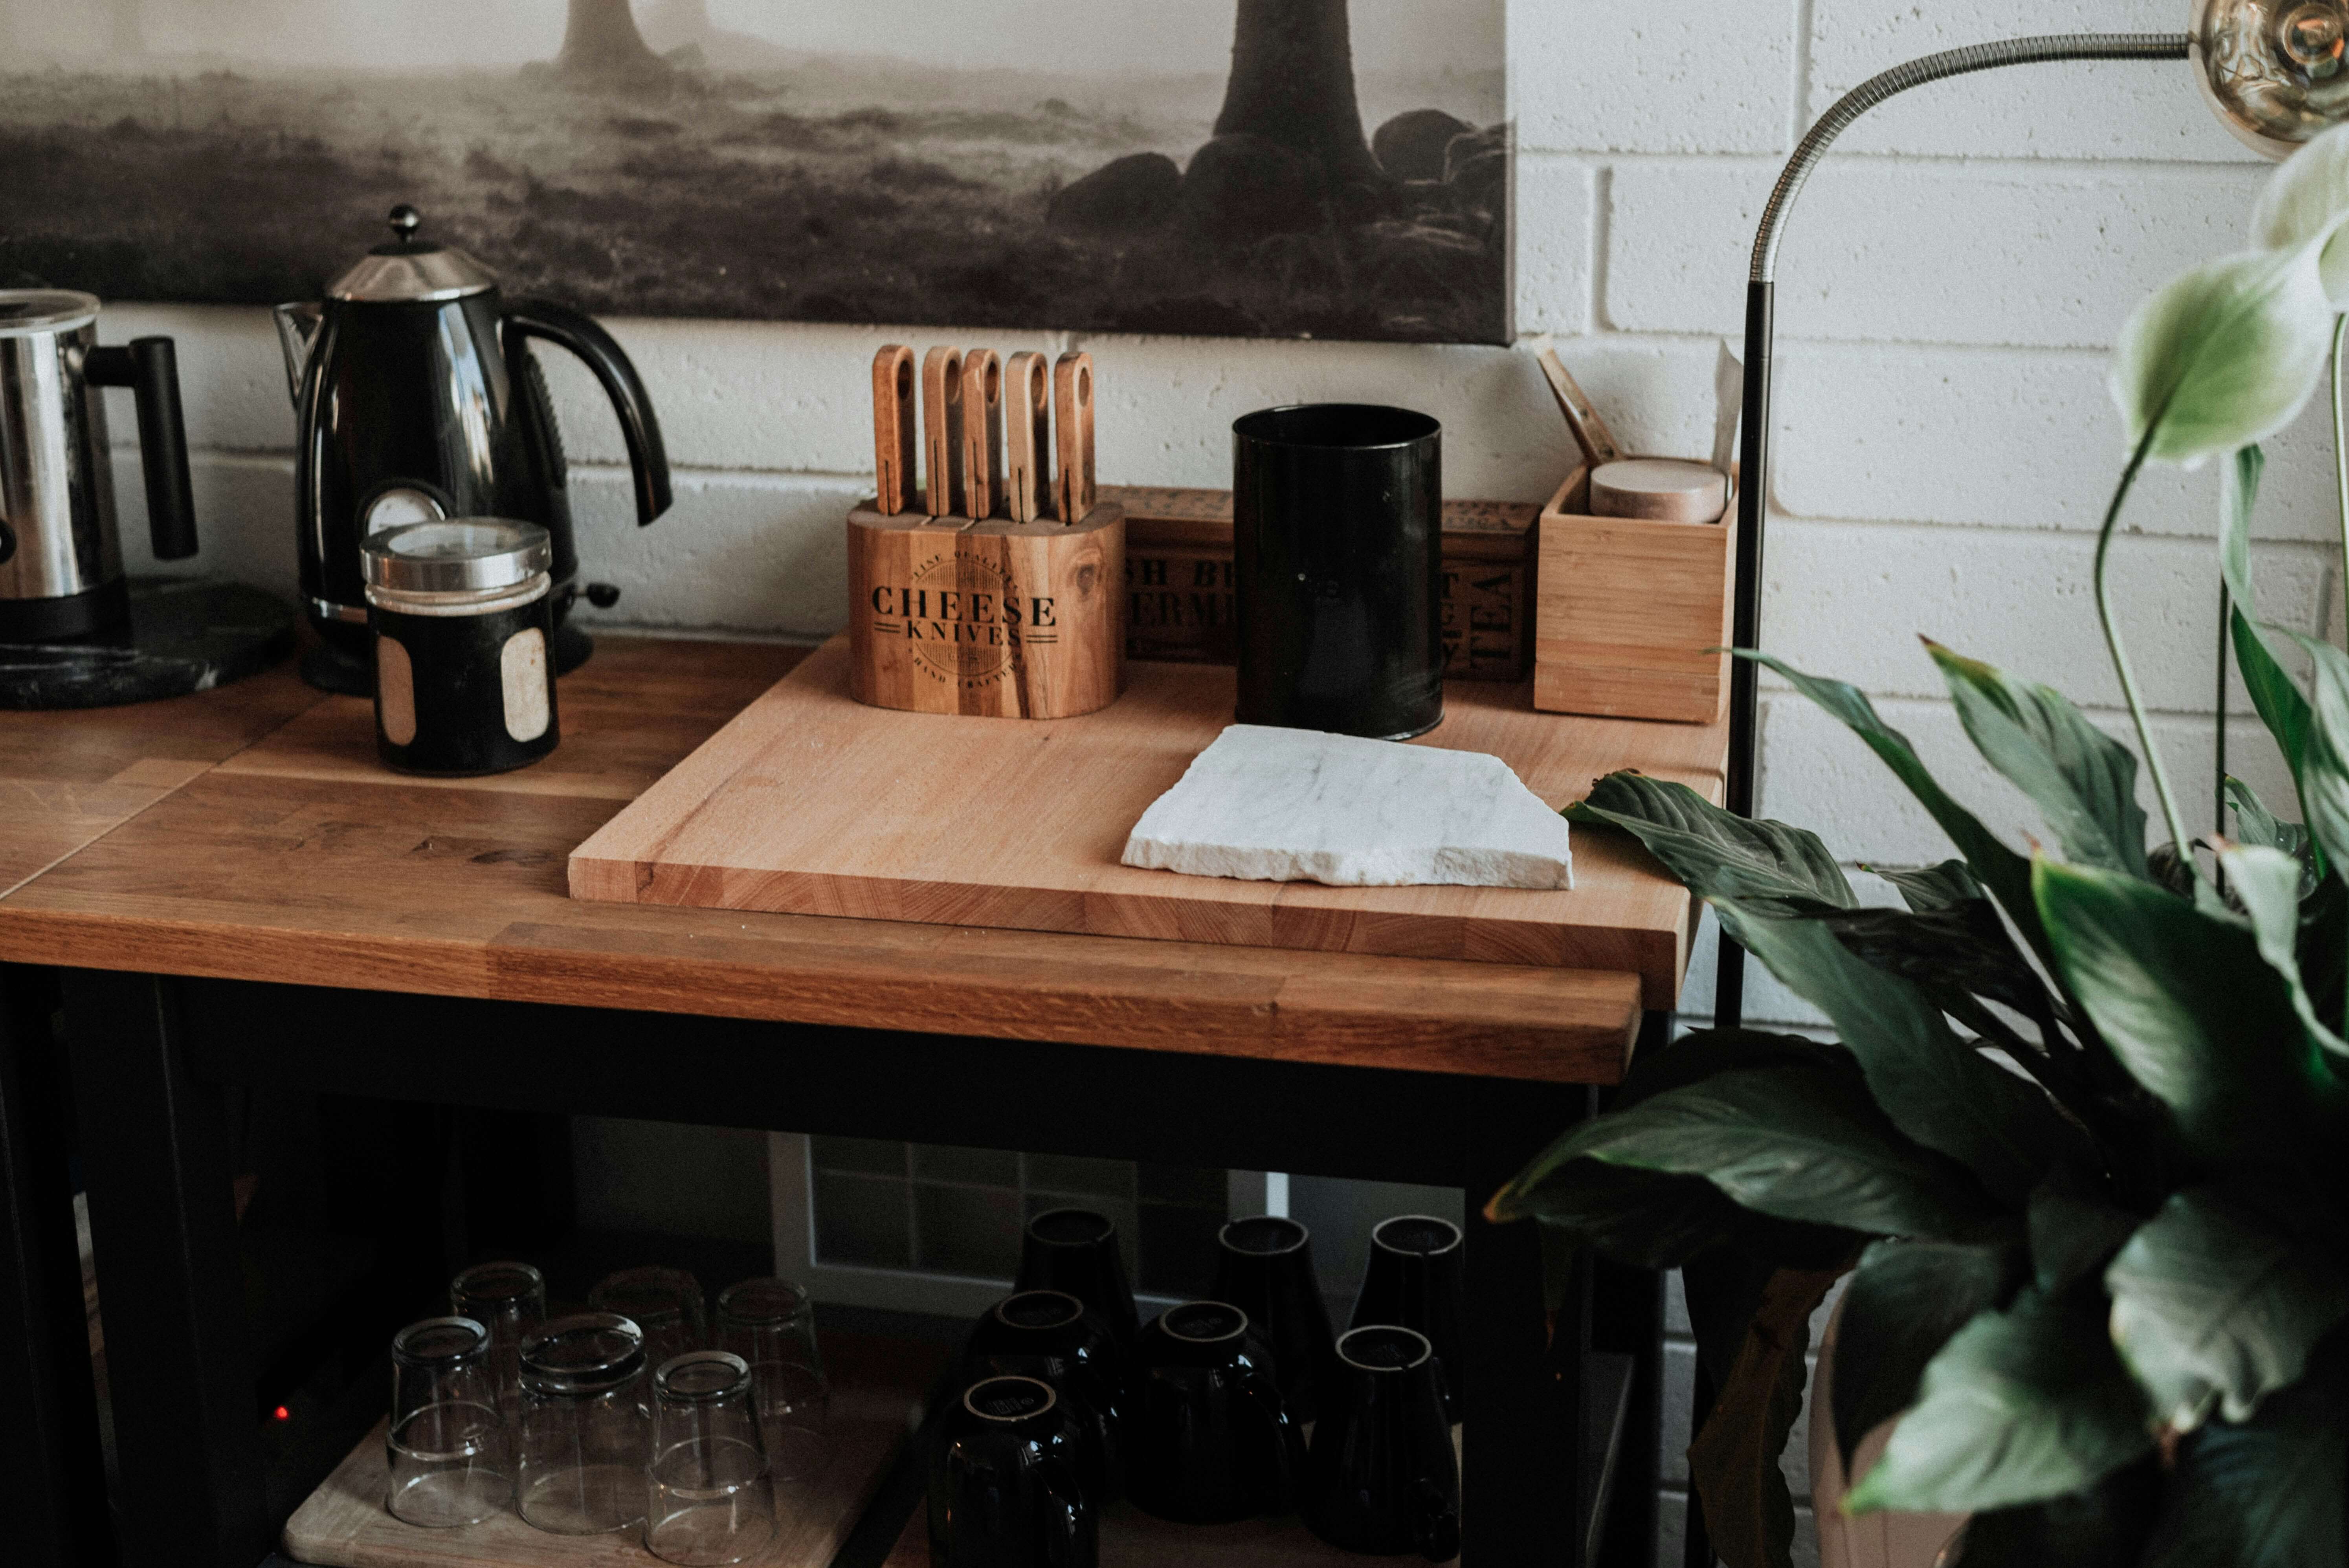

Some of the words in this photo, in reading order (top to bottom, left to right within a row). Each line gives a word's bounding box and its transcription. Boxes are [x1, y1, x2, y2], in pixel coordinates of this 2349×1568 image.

[954, 551, 1012, 582] QUALITY
[872, 586, 1056, 627] CHEESE
[1470, 573, 1511, 668] TEA
[907, 620, 1021, 646] KNIVES
[914, 657, 946, 682] HAND
